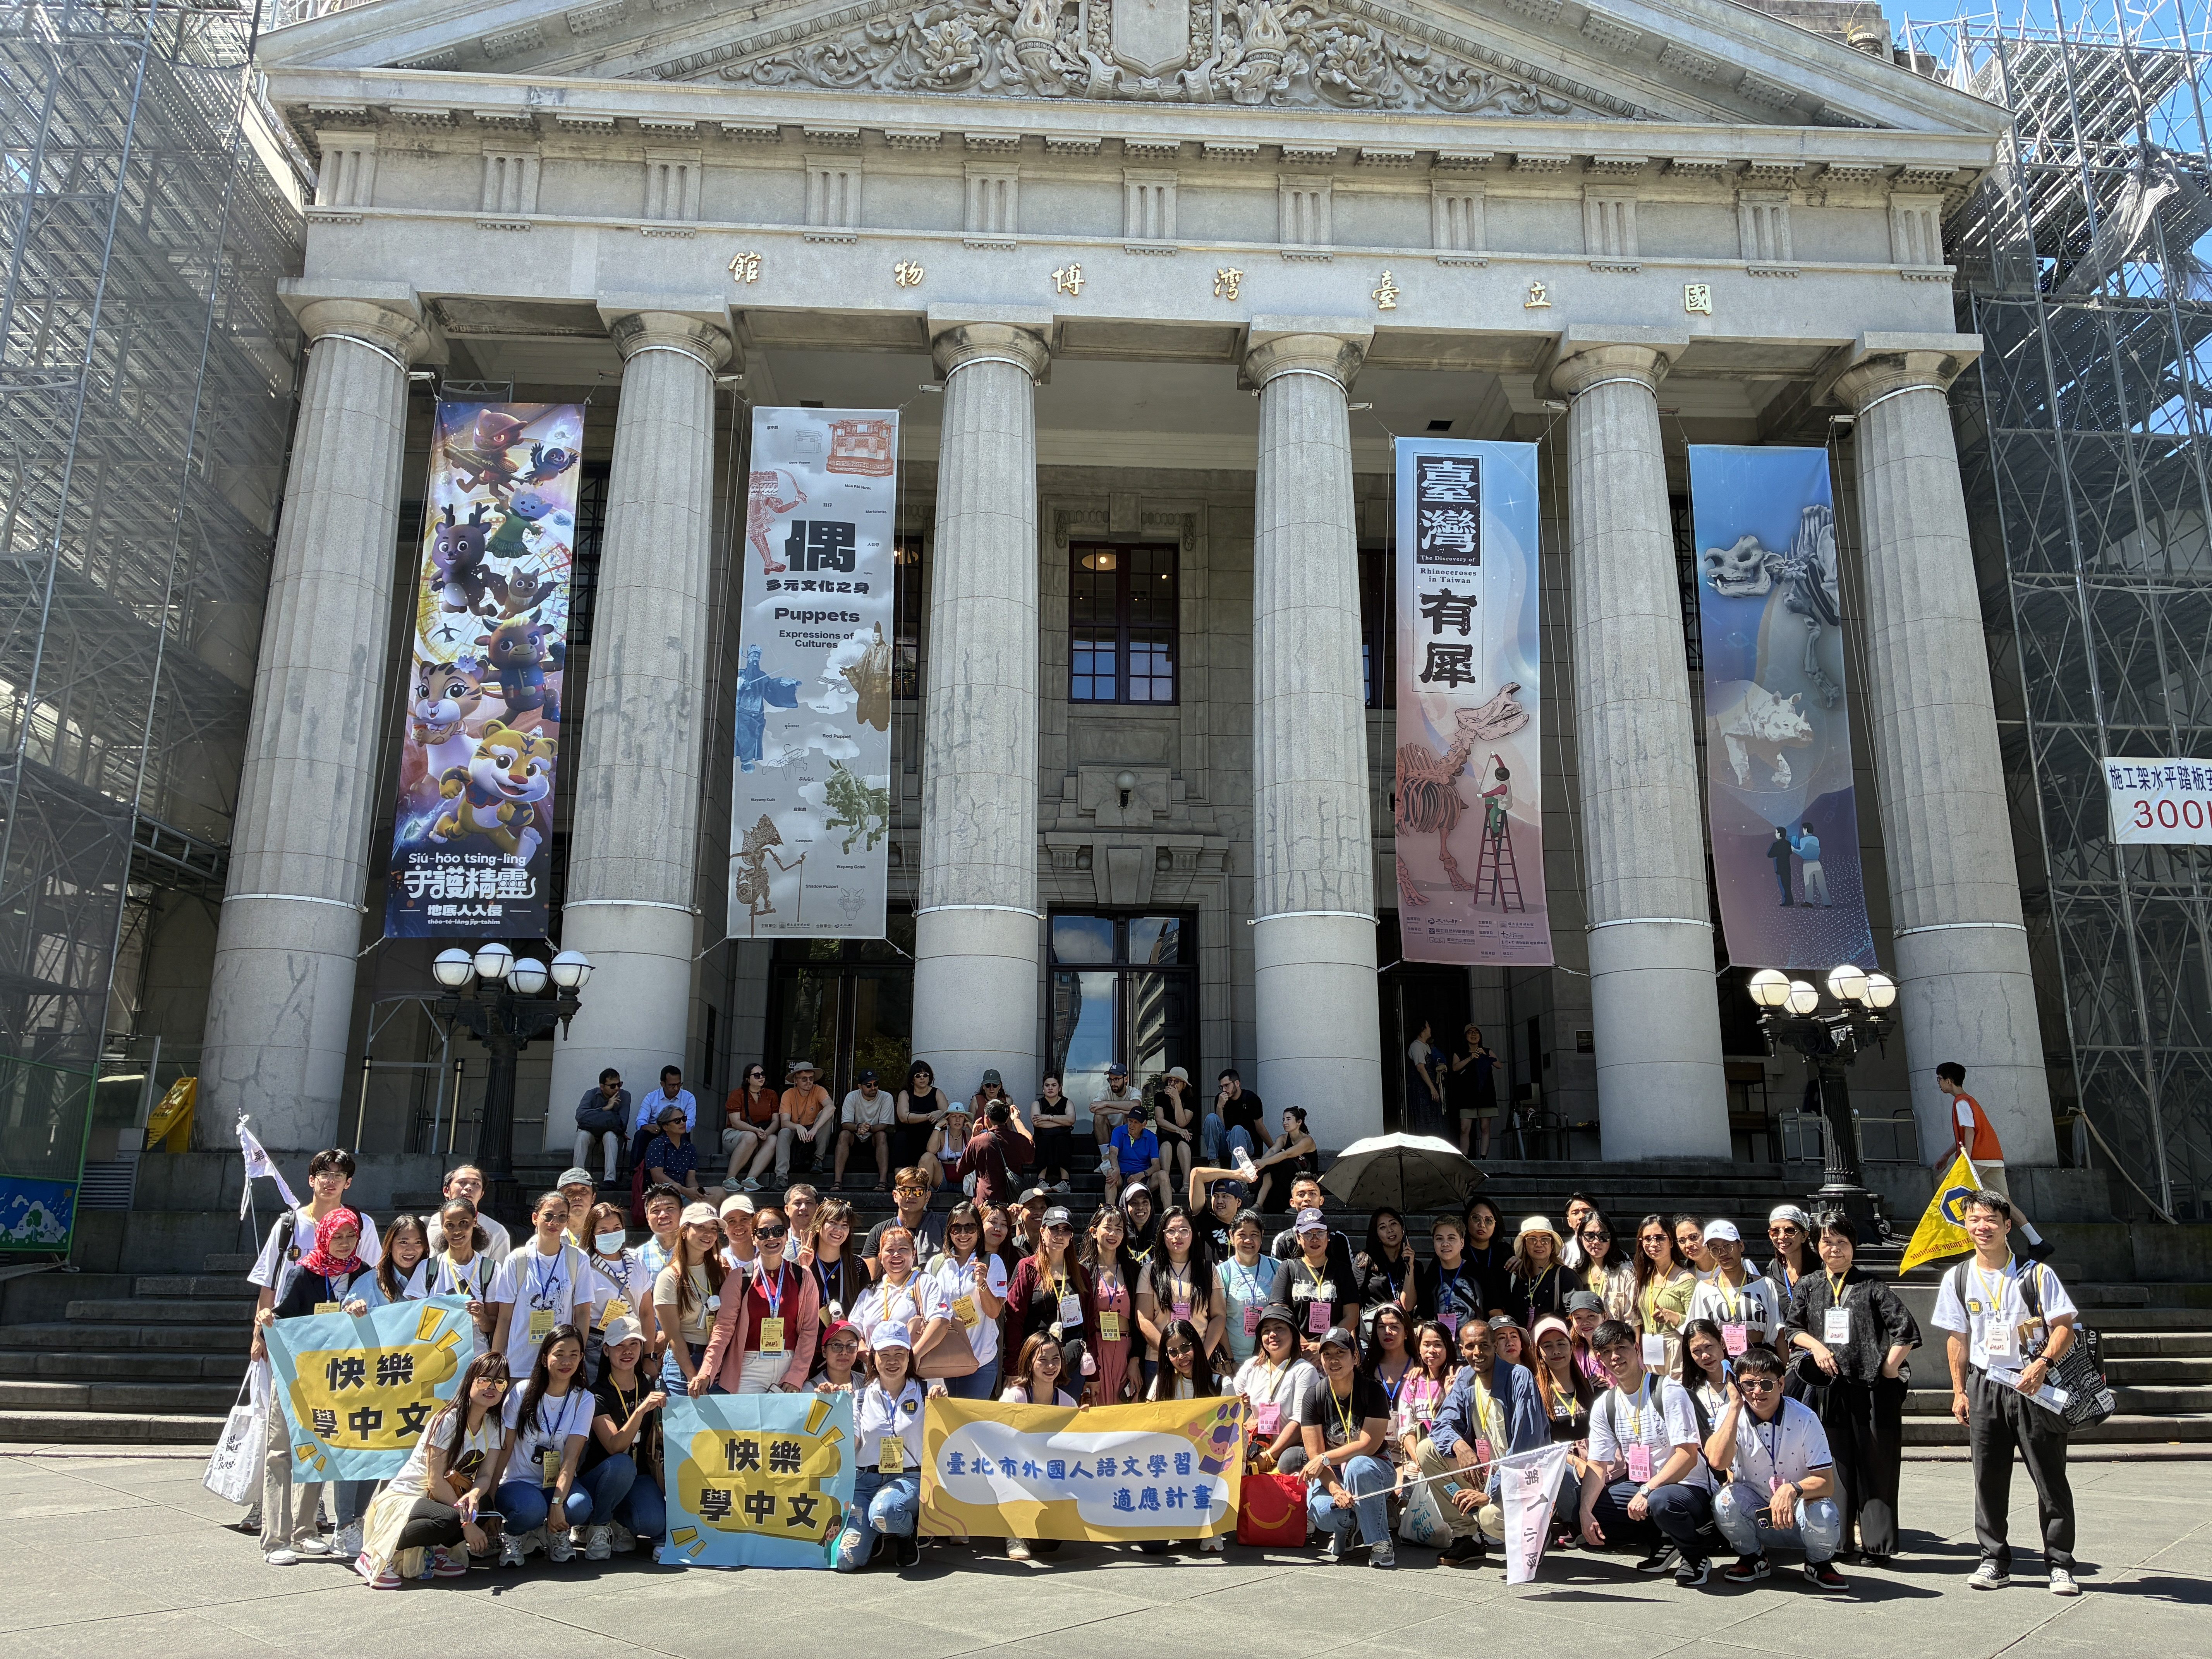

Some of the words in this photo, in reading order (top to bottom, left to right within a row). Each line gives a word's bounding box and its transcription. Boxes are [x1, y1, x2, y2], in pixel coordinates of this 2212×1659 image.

[1420, 460, 1478, 553] 臺灣
[785, 520, 855, 573] 偶
[766, 579, 870, 595] 多元文化之身
[1420, 568, 1477, 577] Rhinoceroses
[774, 607, 860, 624] Puppets
[779, 630, 841, 641] Expressions
[843, 632, 855, 640] of
[795, 639, 838, 649] Cultures
[1419, 587, 1478, 689] 有犀
[409, 852, 460, 864] Siú-hōo
[464, 853, 527, 867] tsing-lîng
[403, 865, 536, 899] 守護精靈
[427, 904, 503, 917] 地底人入侵
[326, 1352, 414, 1392] 快樂
[312, 1401, 433, 1441] 學中文
[725, 1438, 802, 1474] 快樂
[946, 1451, 1192, 1481] 臺北市外國人語文學習
[699, 1489, 818, 1529] 學中文
[1112, 1484, 1214, 1513] 適應計畫
